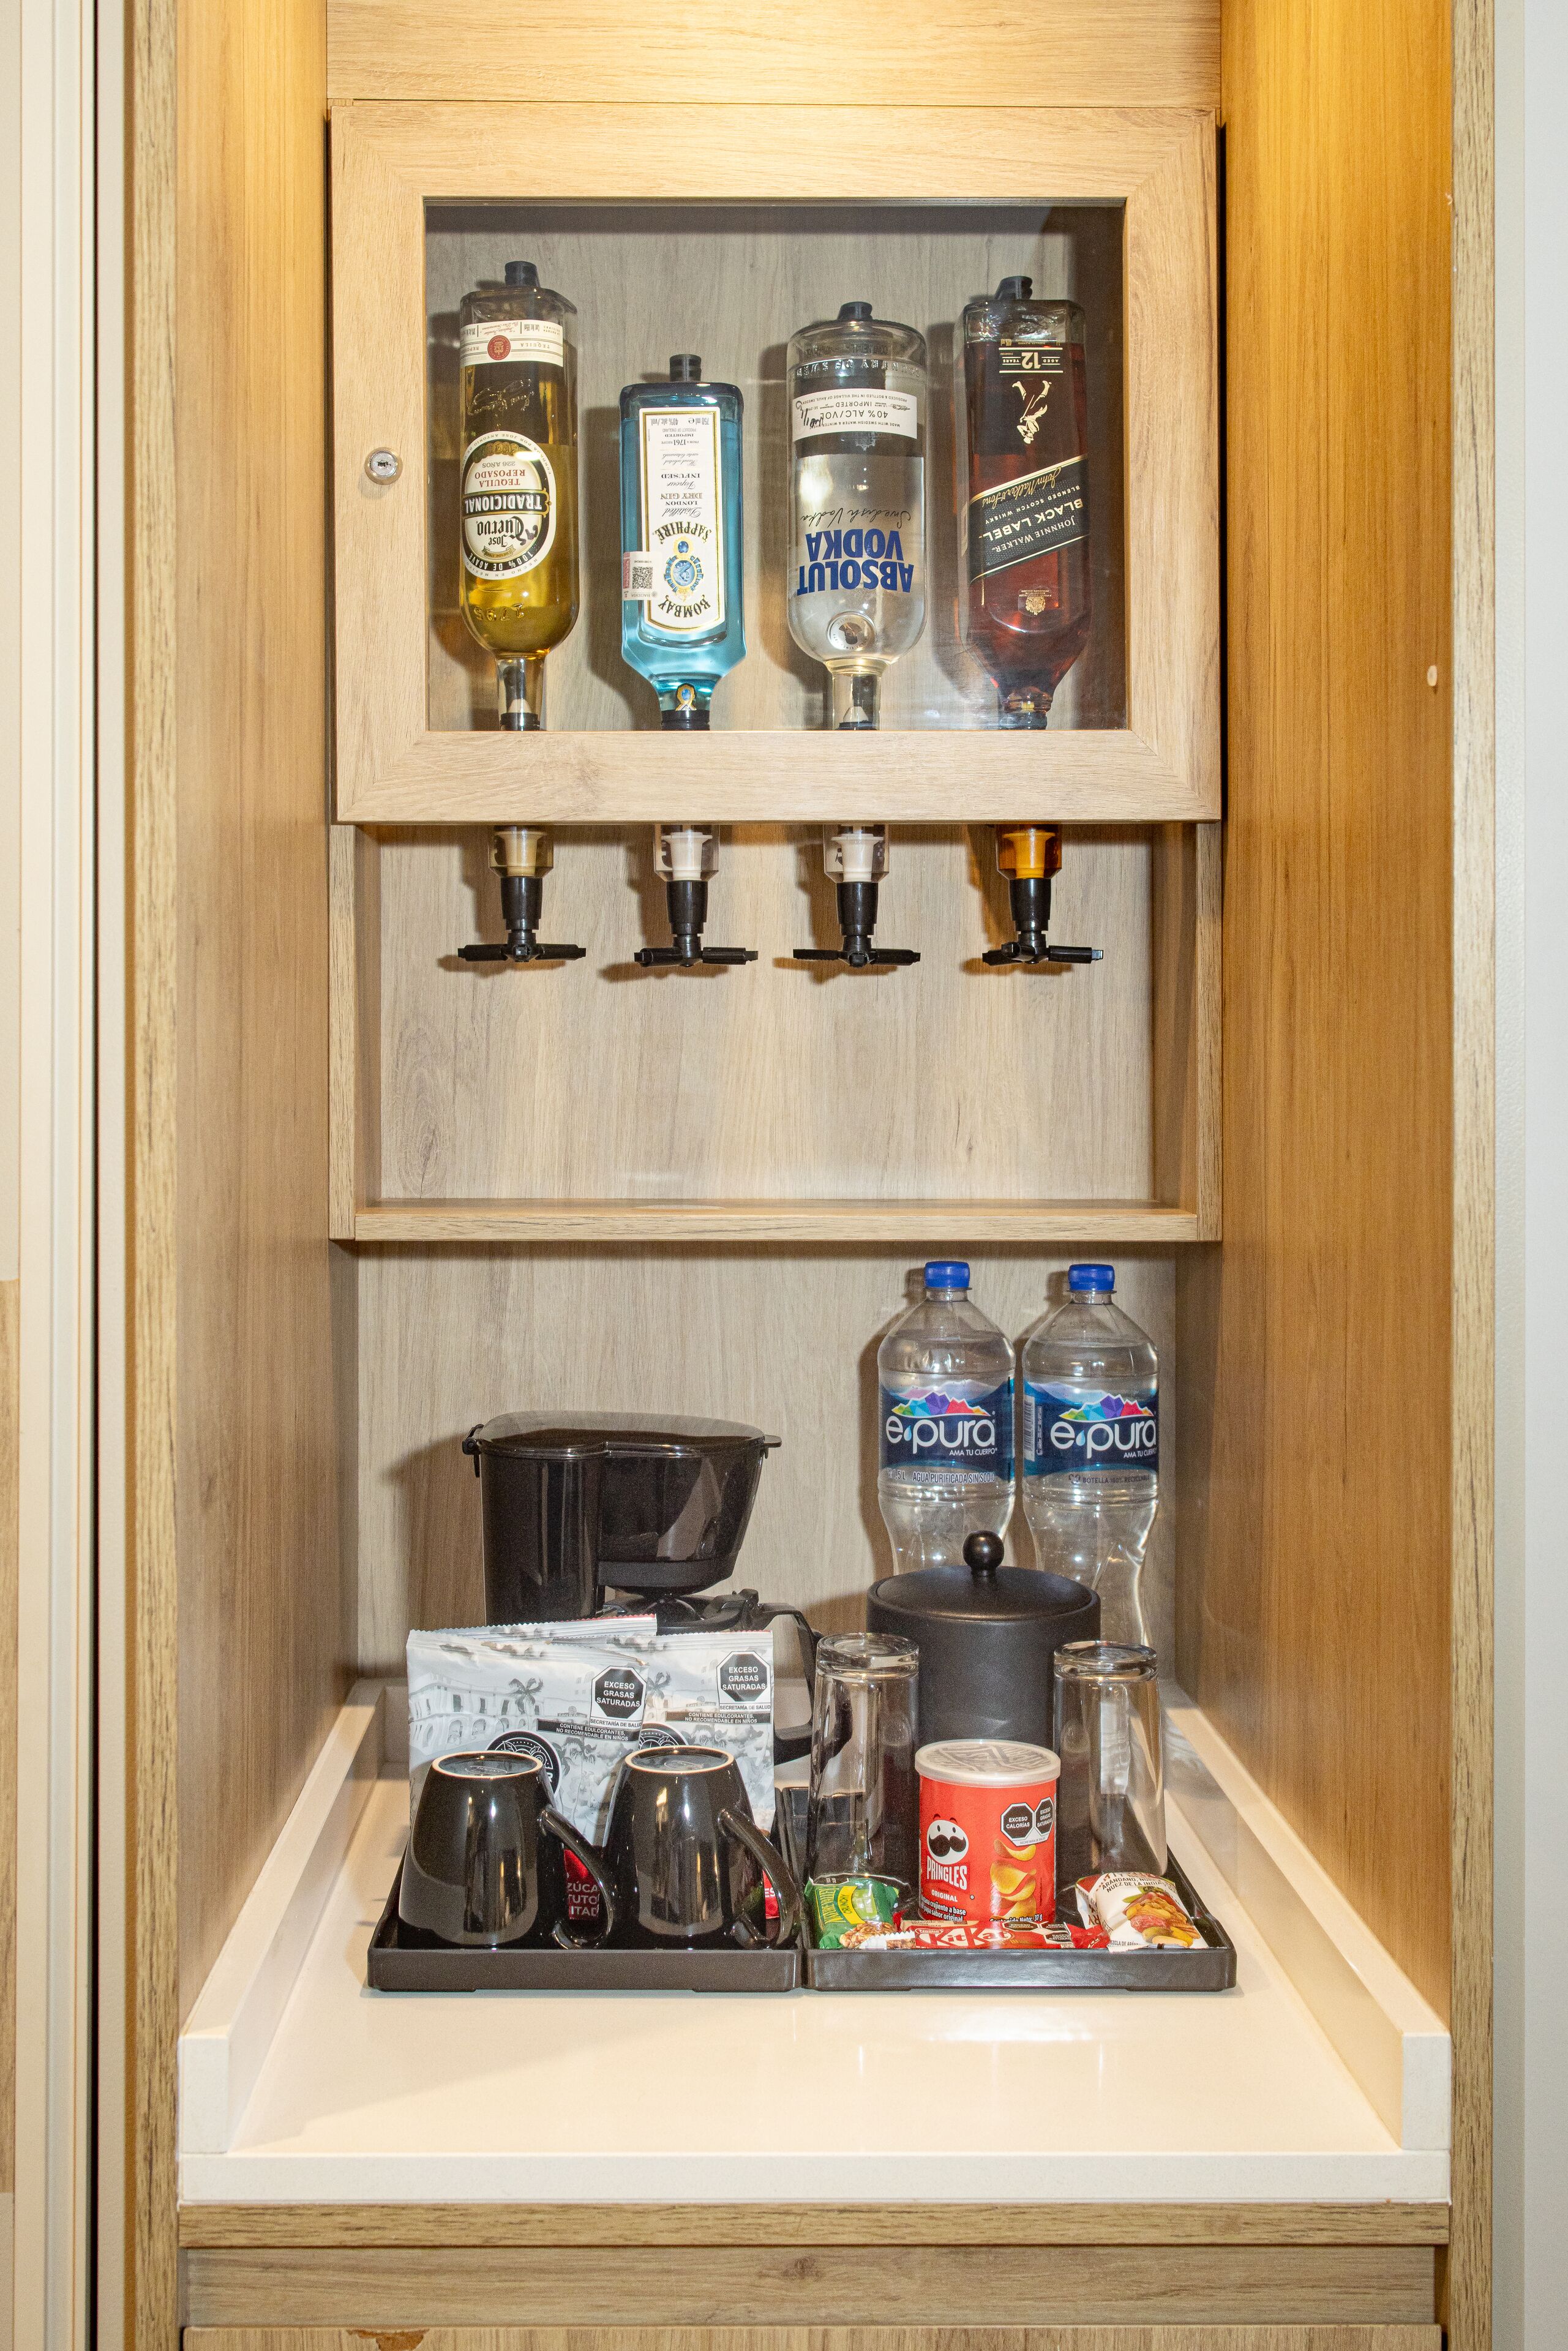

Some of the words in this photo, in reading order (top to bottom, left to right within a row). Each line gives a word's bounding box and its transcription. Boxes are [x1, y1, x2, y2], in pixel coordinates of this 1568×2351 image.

[1021, 352, 1041, 369] 12
[820, 410, 865, 420] ALC/VOL
[868, 410, 888, 419] 40%
[475, 469, 525, 479] REPOSADO
[1035, 465, 1062, 490] John
[479, 478, 520, 488] TEQUILA
[667, 479, 696, 490] Vapour
[1005, 479, 1036, 500] Walker
[1047, 485, 1081, 501] BLENDED
[465, 494, 542, 514] TRADICIONAL
[1016, 498, 1045, 513] SCOTCH
[1034, 498, 1084, 524] BLACK
[662, 508, 703, 518] Distilled
[800, 508, 844, 528] Vodka
[847, 509, 911, 529] Swedish
[985, 510, 1013, 525] WHISKY
[477, 516, 527, 542] Cuervo
[655, 521, 711, 544] SAPPHIRE
[982, 517, 1032, 542] LABEL
[1034, 516, 1076, 538] JOHNNIE
[488, 534, 508, 547] Jose
[805, 528, 904, 562] VODKA
[994, 534, 1034, 553] WALKER
[468, 552, 489, 571] AGAVE
[508, 551, 533, 569] 100%
[797, 560, 915, 596] ABSOLUT
[658, 594, 711, 618] BOMBAY
[912, 1472, 929, 1483] AGUA
[930, 1472, 967, 1484] PURIFICADA
[968, 1472, 979, 1483] SIN
[980, 1471, 996, 1482] SODIO
[604, 1681, 635, 1690] EXCESO
[603, 1689, 635, 1698] GRASAS
[596, 1697, 640, 1708] SATURADAS
[565, 1729, 604, 1739] RECOMENDABLE
[584, 1727, 626, 1736] EDULCORANTES,
[1040, 1812, 1051, 1821] GRASAS
[926, 1855, 967, 1891] PRINGLES
[1106, 1882, 1122, 1893] NUEZ
[931, 1889, 958, 1902] ORIGINAL
[930, 1901, 948, 1913] crujiente
[953, 1906, 967, 1916] base
[931, 1908, 943, 1919] sabor
[943, 1913, 964, 1923] original
